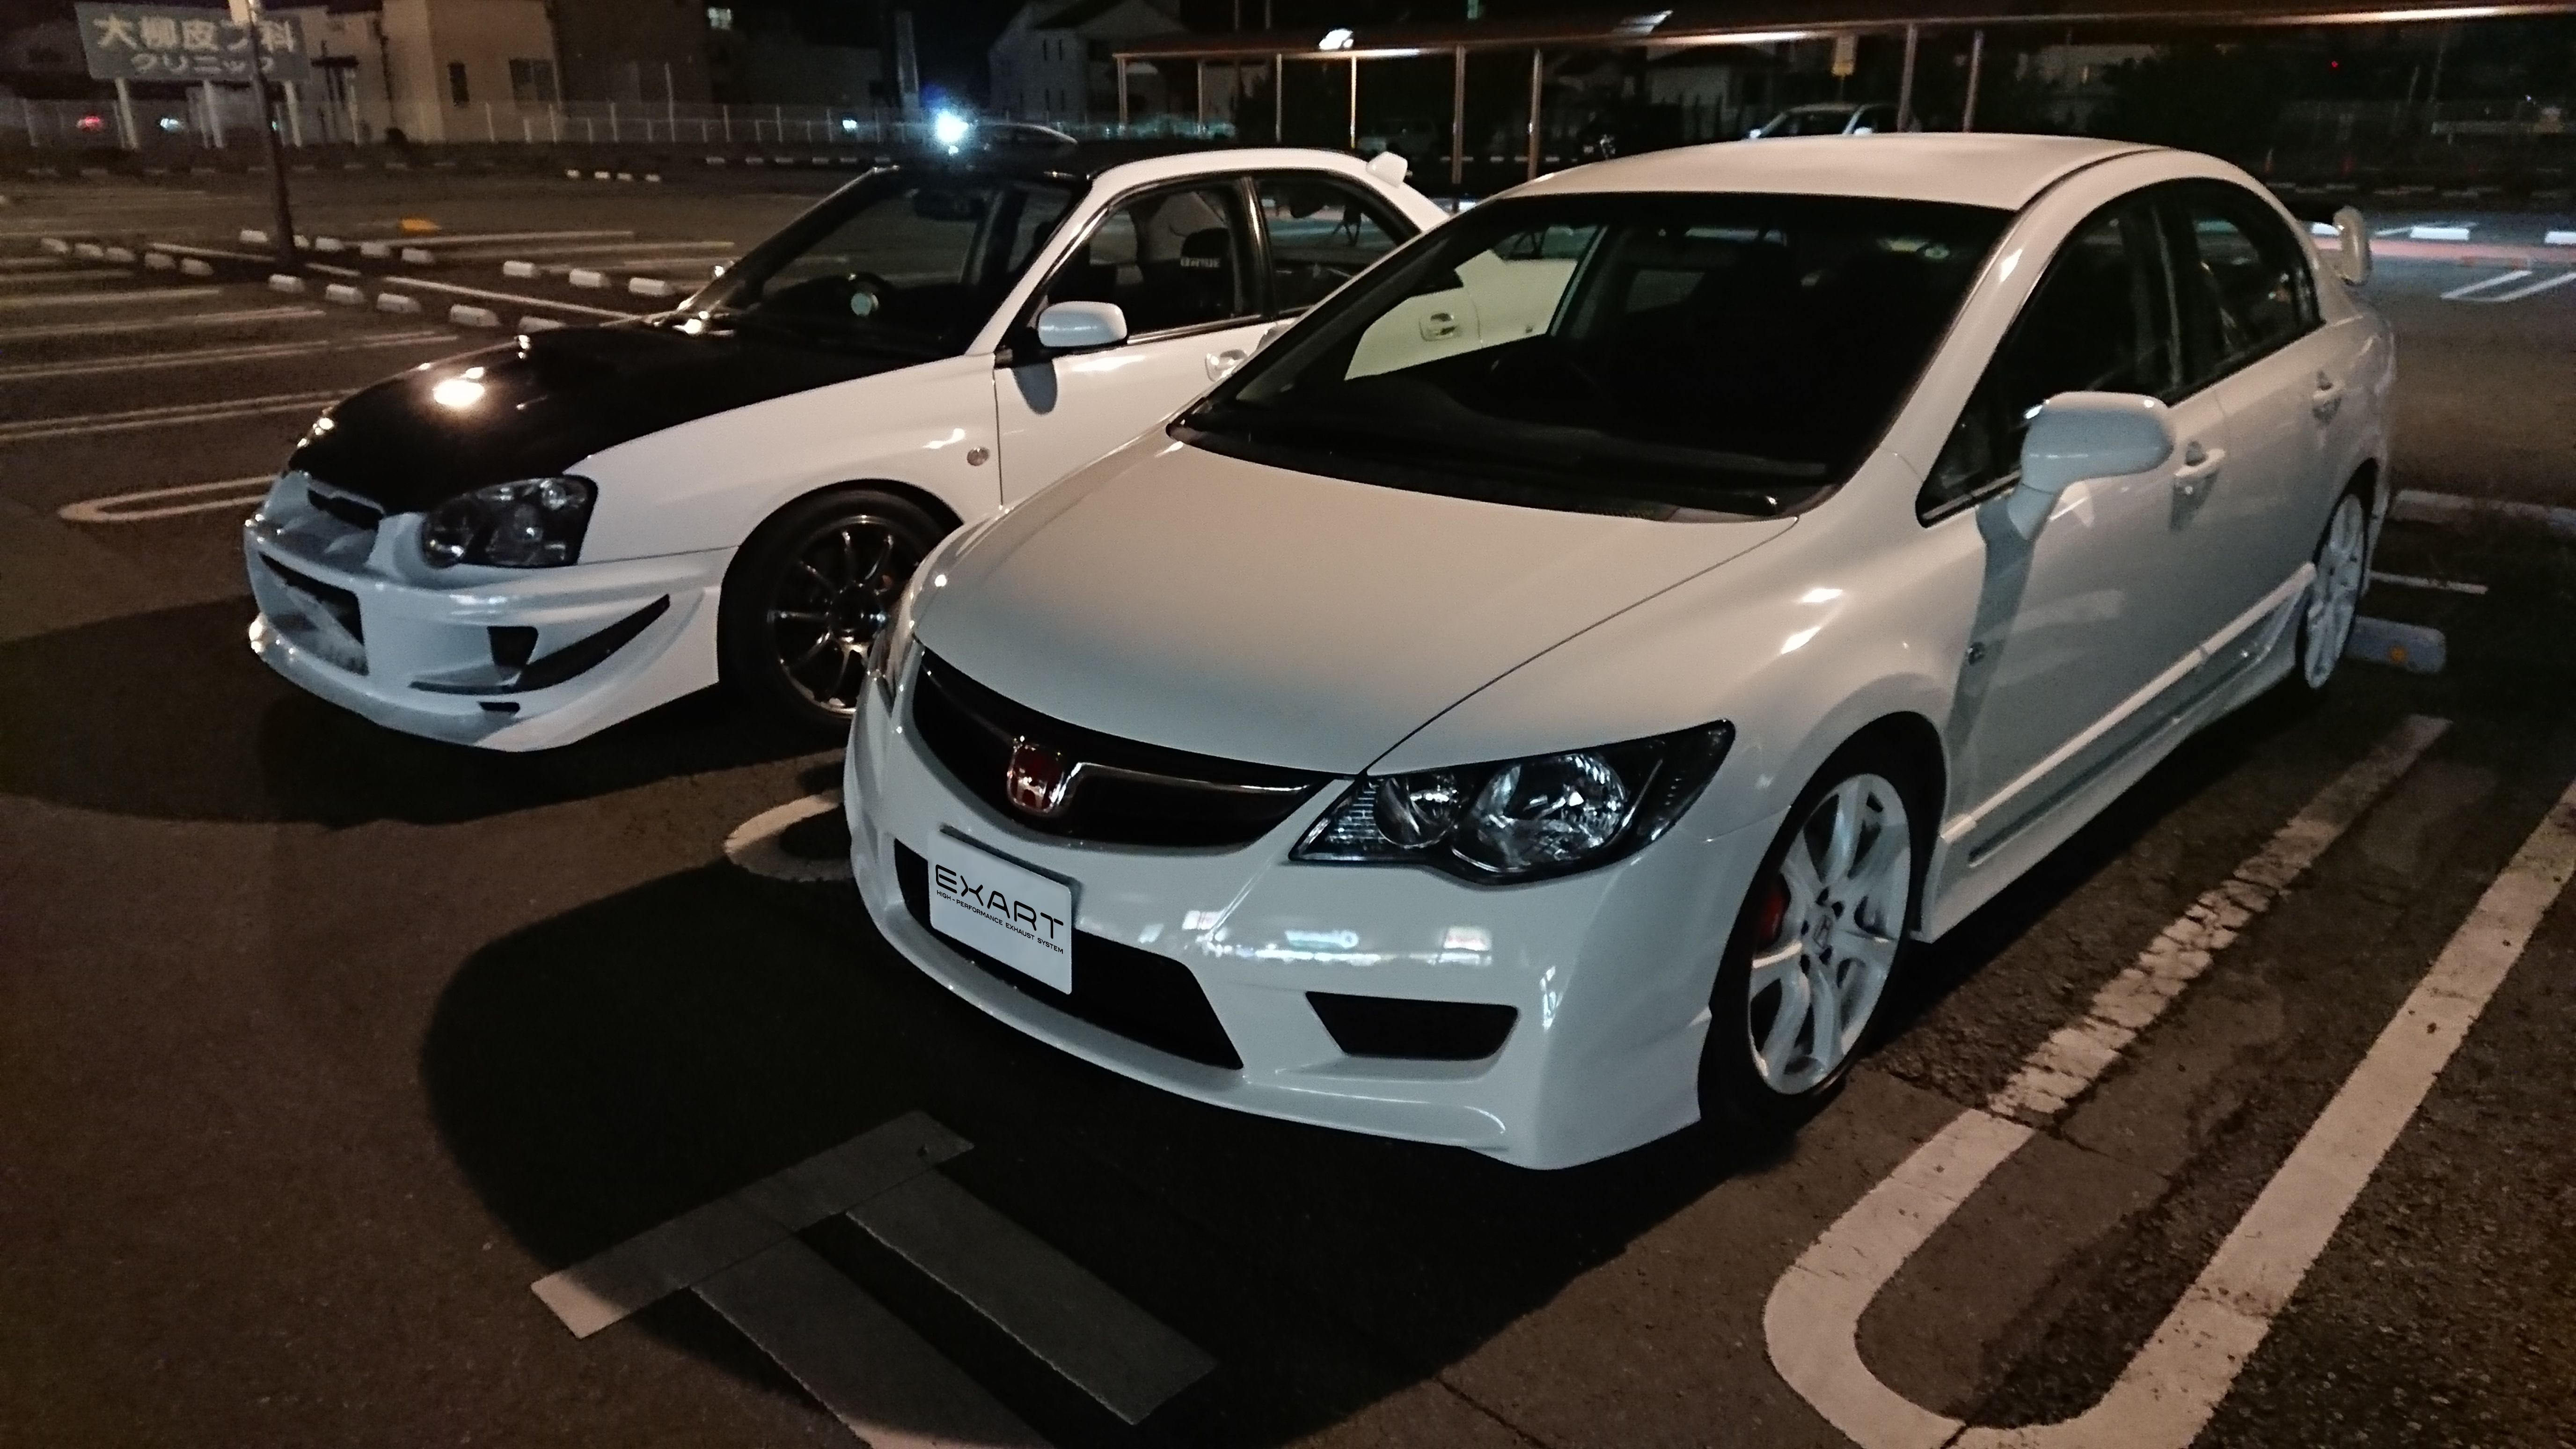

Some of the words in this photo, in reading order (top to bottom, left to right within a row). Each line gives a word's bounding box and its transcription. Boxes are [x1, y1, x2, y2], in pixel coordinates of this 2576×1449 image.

[935, 864, 1064, 939] EXART
[1005, 922, 1035, 940] EXHAUST
[1037, 937, 1063, 954] SYSTEM
